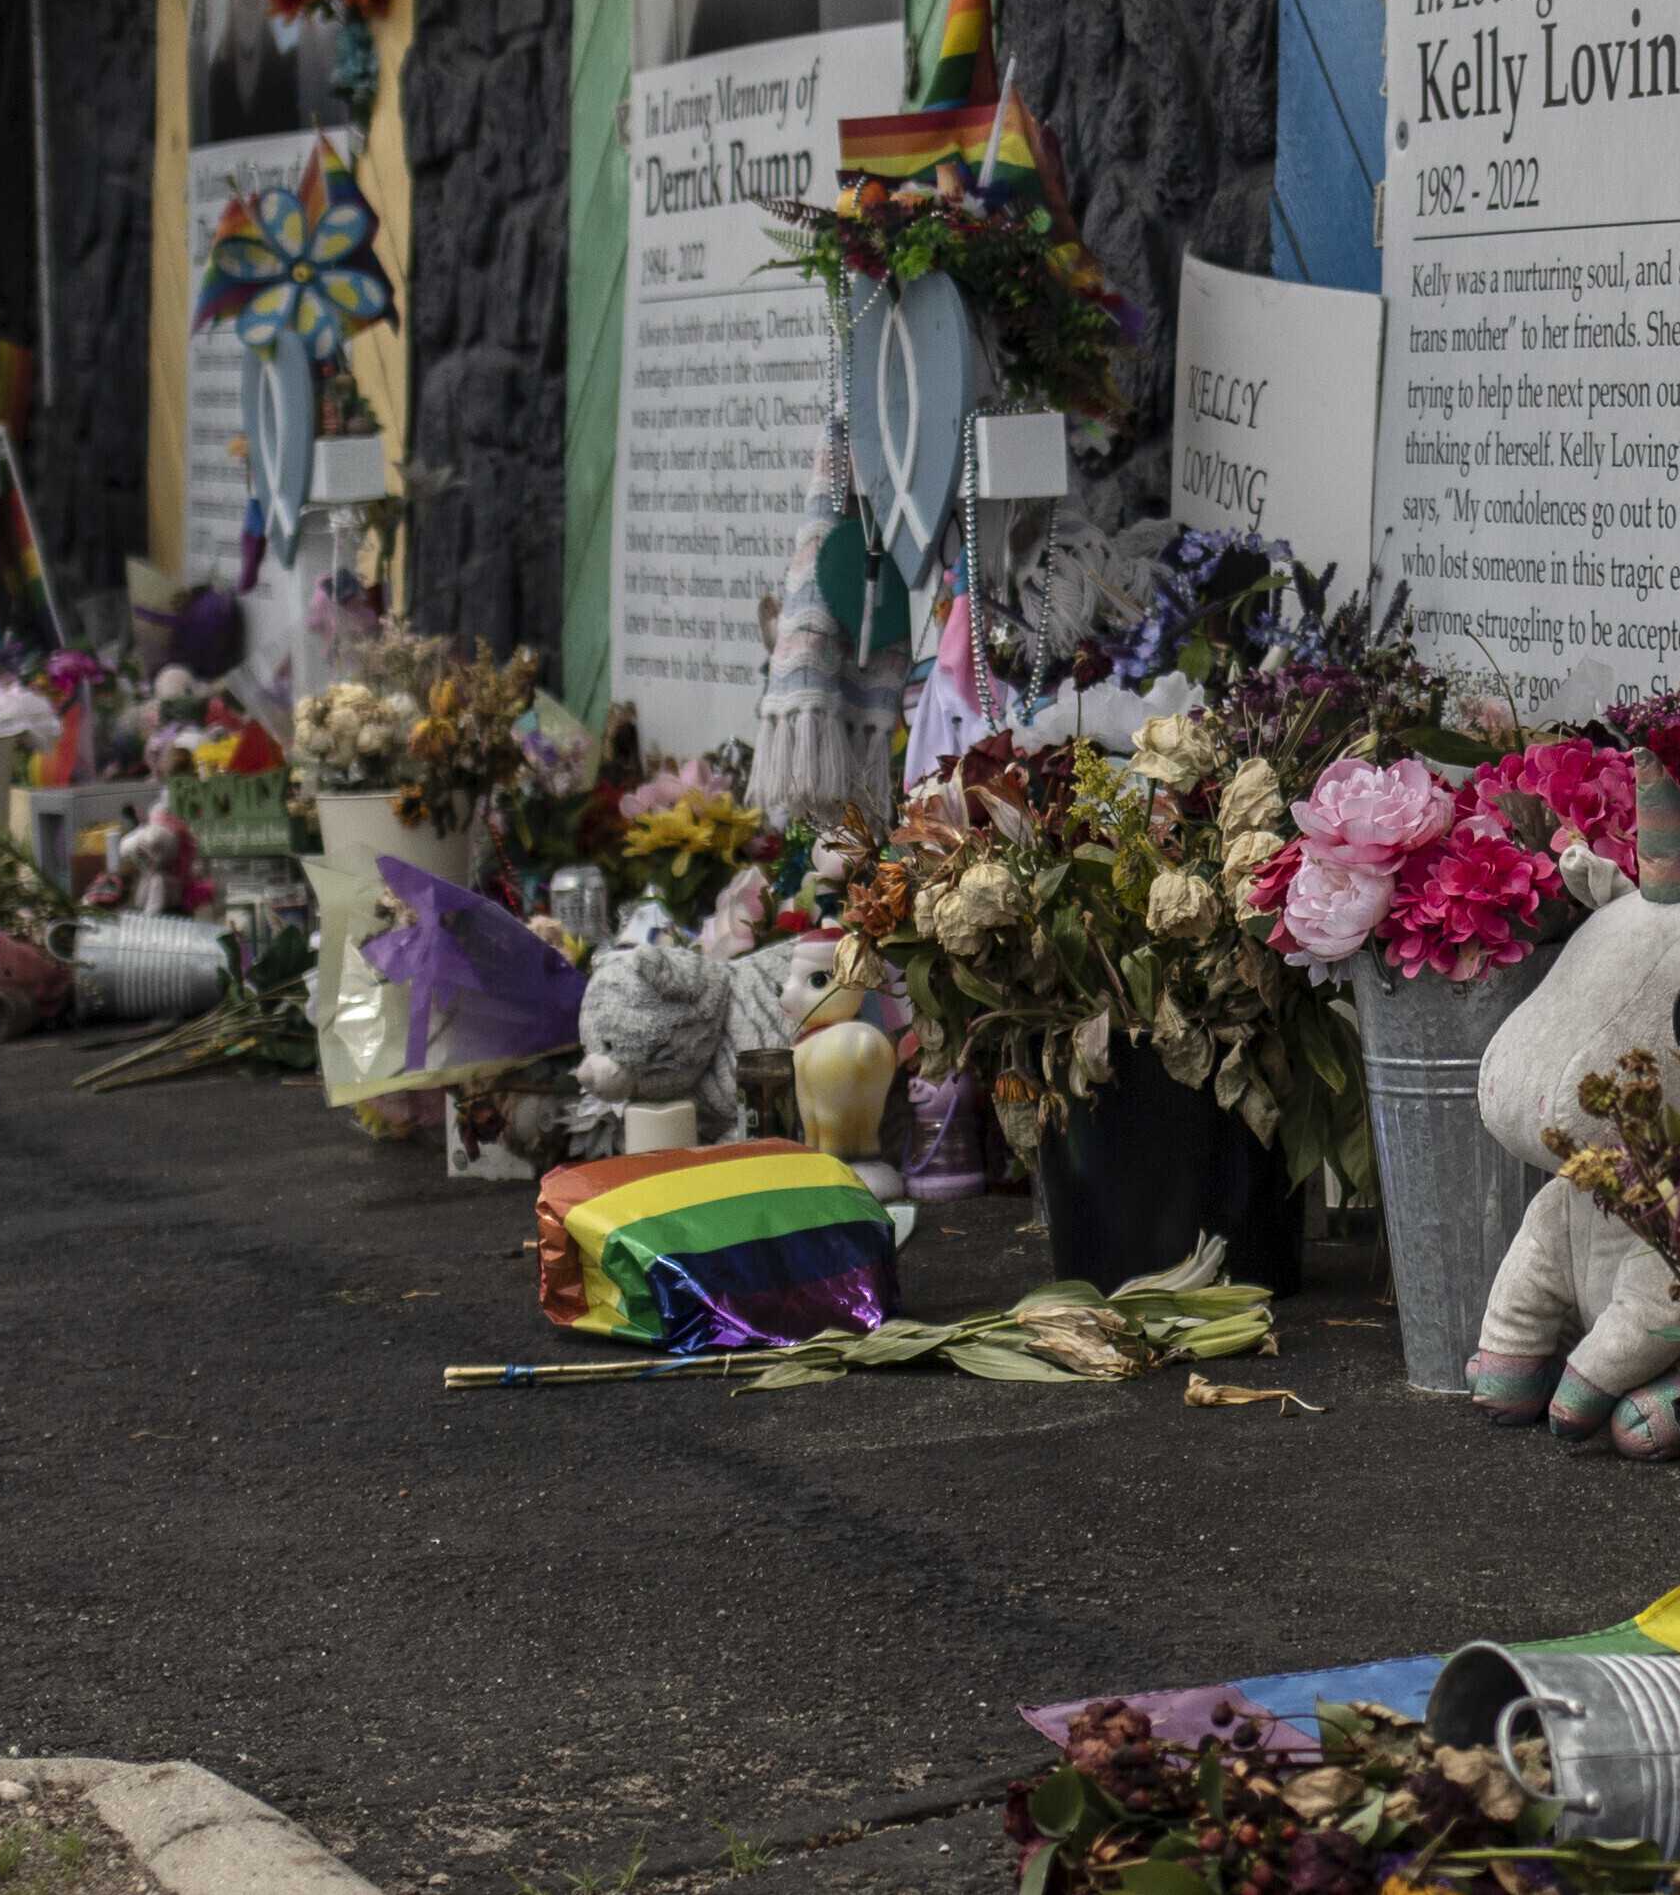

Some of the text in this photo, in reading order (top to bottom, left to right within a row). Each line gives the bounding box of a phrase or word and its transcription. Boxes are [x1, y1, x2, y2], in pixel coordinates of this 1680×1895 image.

[645, 56, 820, 142] In Loving Memory of
[1417, 27, 1528, 144] Kelly
[645, 139, 812, 217] Derrick Rump
[1417, 164, 1465, 216] 1982
[1486, 157, 1539, 210] 2022
[1412, 263, 1451, 306] Kelly
[1456, 271, 1486, 294] was
[1504, 258, 1583, 302] nurturing
[1588, 252, 1629, 291] soul,
[1635, 249, 1671, 286] and
[1410, 326, 1447, 353] trans
[1452, 316, 1516, 351] mother”
[1542, 315, 1569, 349] her
[1574, 311, 1641, 348] friends.
[1188, 365, 1268, 429] KELLY
[1408, 381, 1454, 420] trying
[1478, 374, 1512, 420] help
[1518, 373, 1543, 408] the
[1547, 378, 1583, 408] next
[1589, 383, 1650, 419] person
[1406, 431, 1471, 477] thinking
[1496, 431, 1554, 466] herself.
[1560, 432, 1605, 478] Kelly
[1183, 446, 1267, 532] LOVING
[1403, 498, 1439, 531] says,
[1445, 489, 1481, 533] “My
[1485, 489, 1586, 526] condolences
[1620, 498, 1652, 528] out
[1402, 543, 1435, 576] who
[1440, 544, 1468, 579] lost
[1473, 557, 1546, 583] someone
[1573, 550, 1605, 587] this
[1611, 558, 1664, 601] tragic
[1401, 609, 1472, 646] eeryone
[1477, 606, 1564, 655] struggling
[1529, 668, 1572, 712] goo
